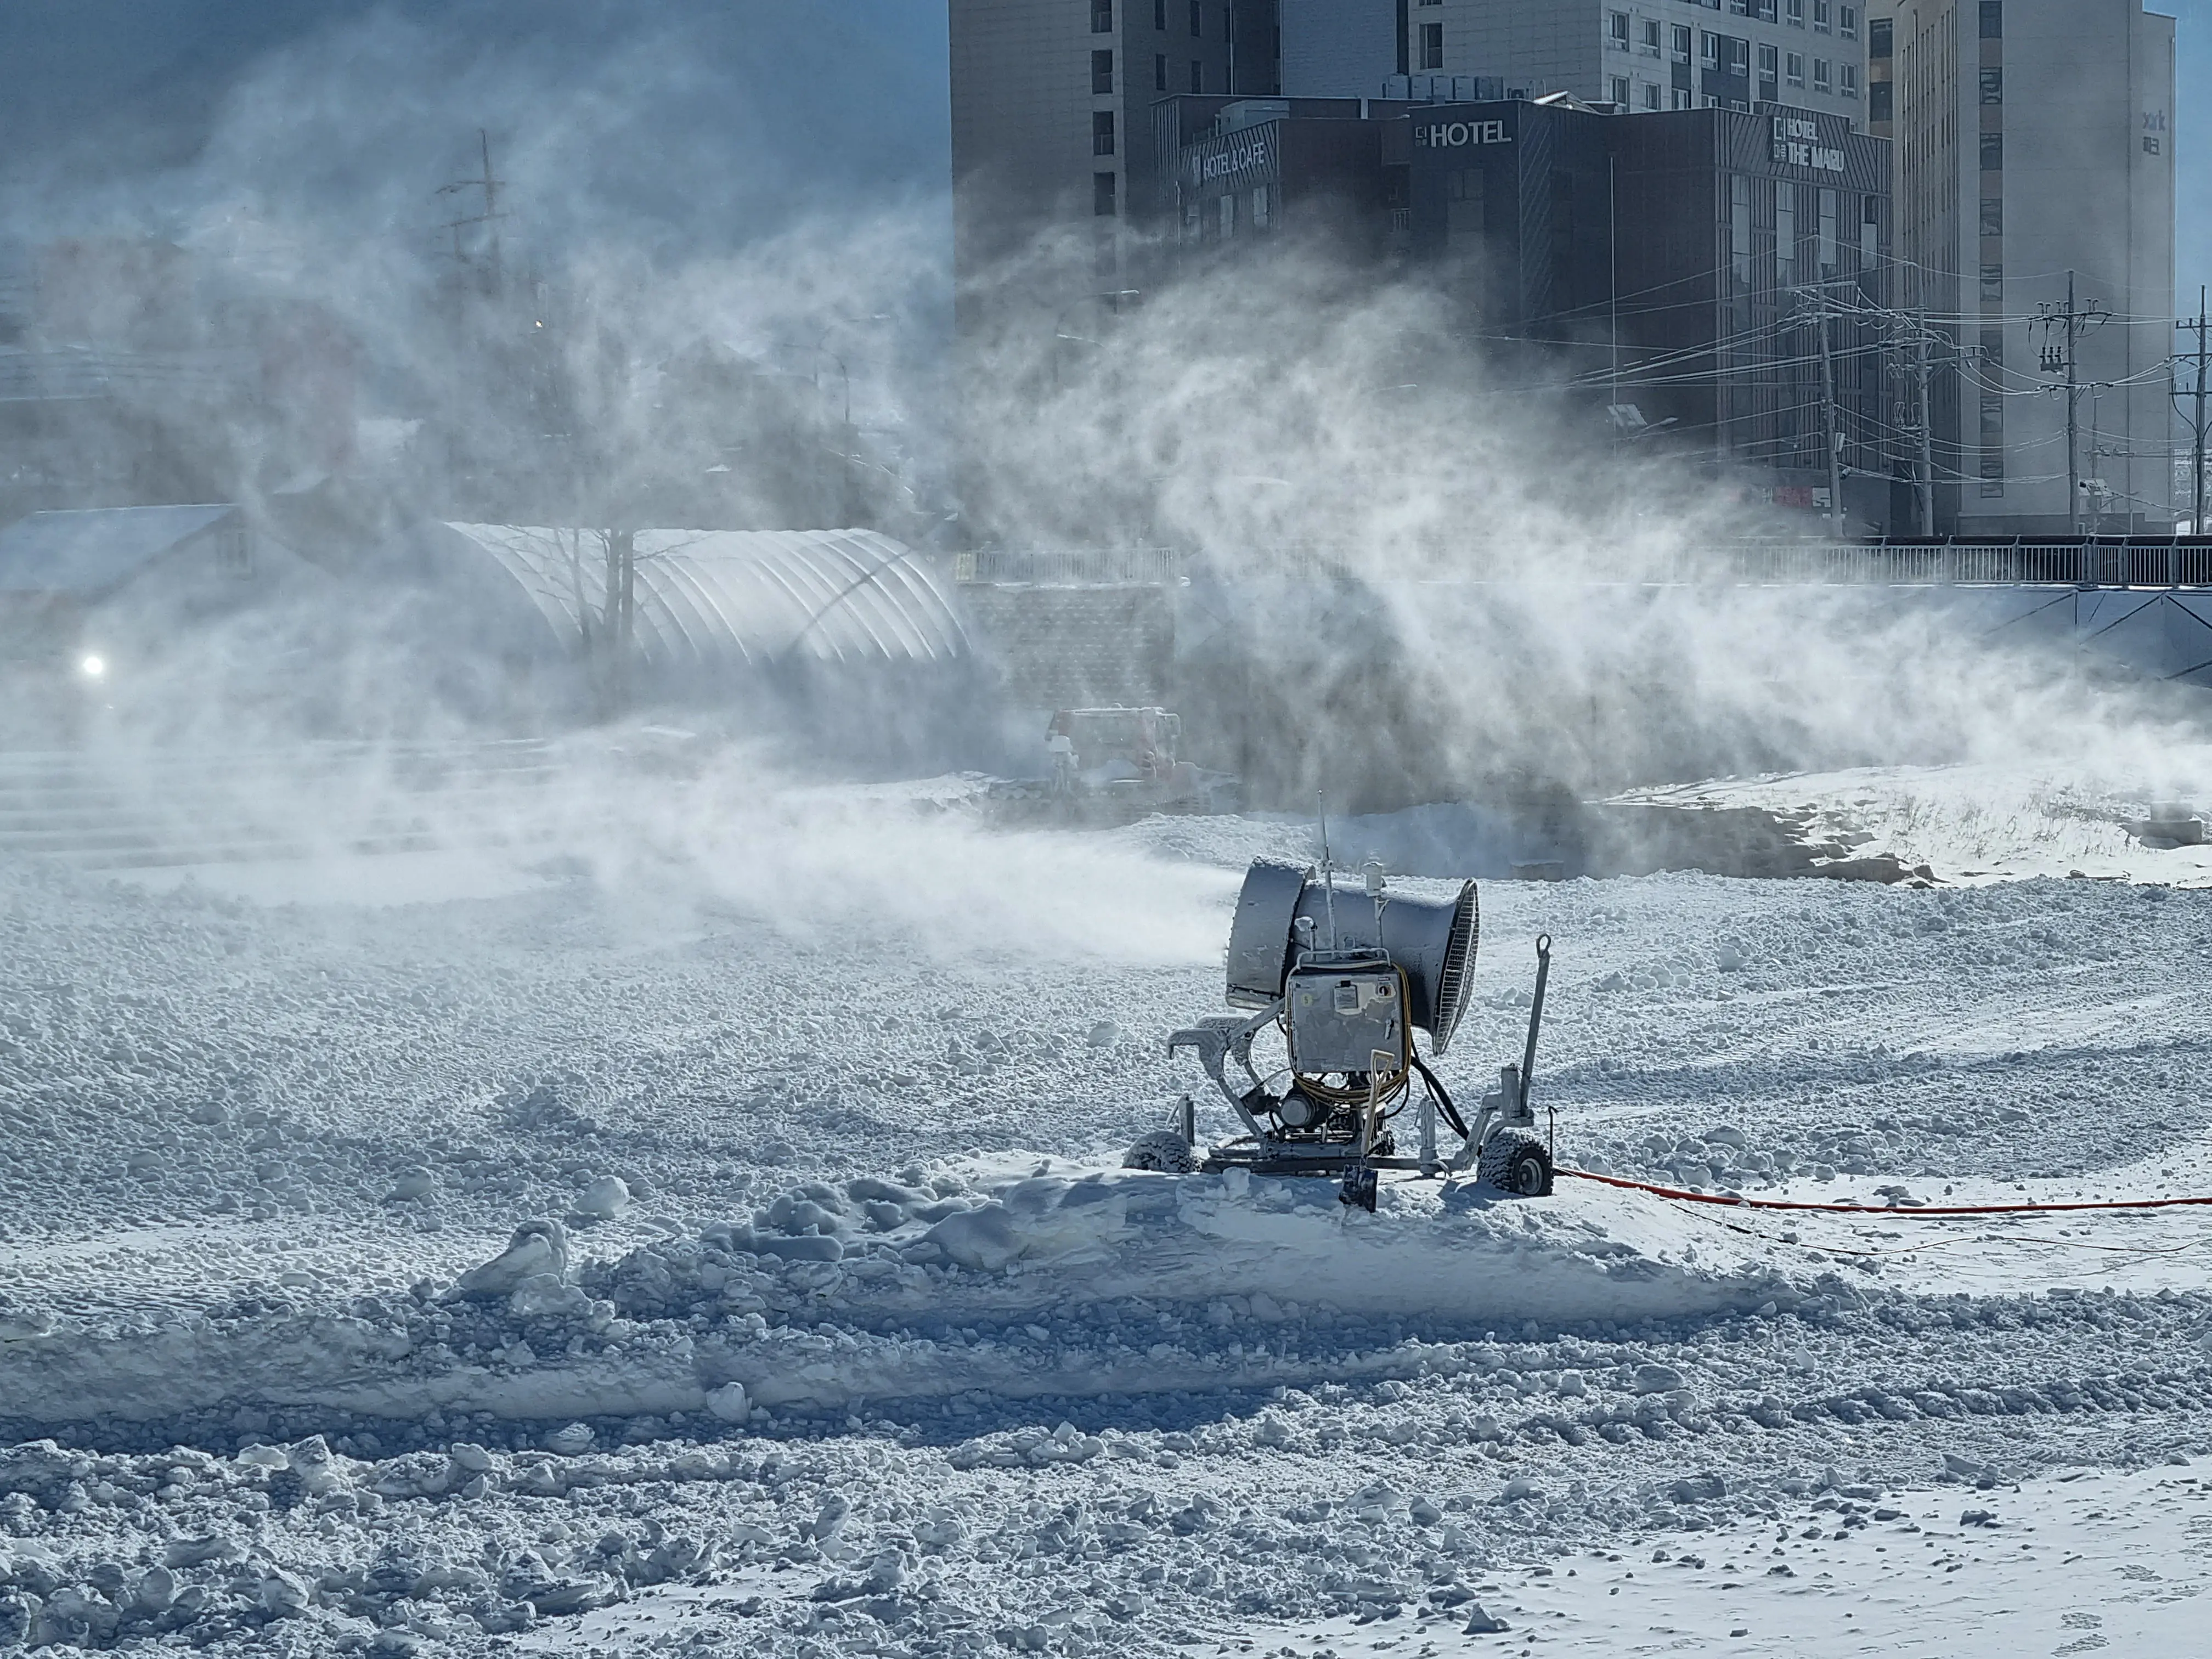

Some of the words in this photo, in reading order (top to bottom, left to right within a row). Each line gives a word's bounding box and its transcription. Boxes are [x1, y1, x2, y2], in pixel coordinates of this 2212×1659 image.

[1431, 120, 1513, 148] HOTEL
[1787, 117, 1818, 140] HOTEL
[1204, 152, 1231, 180] HOTEL
[1788, 142, 1809, 166] THE
